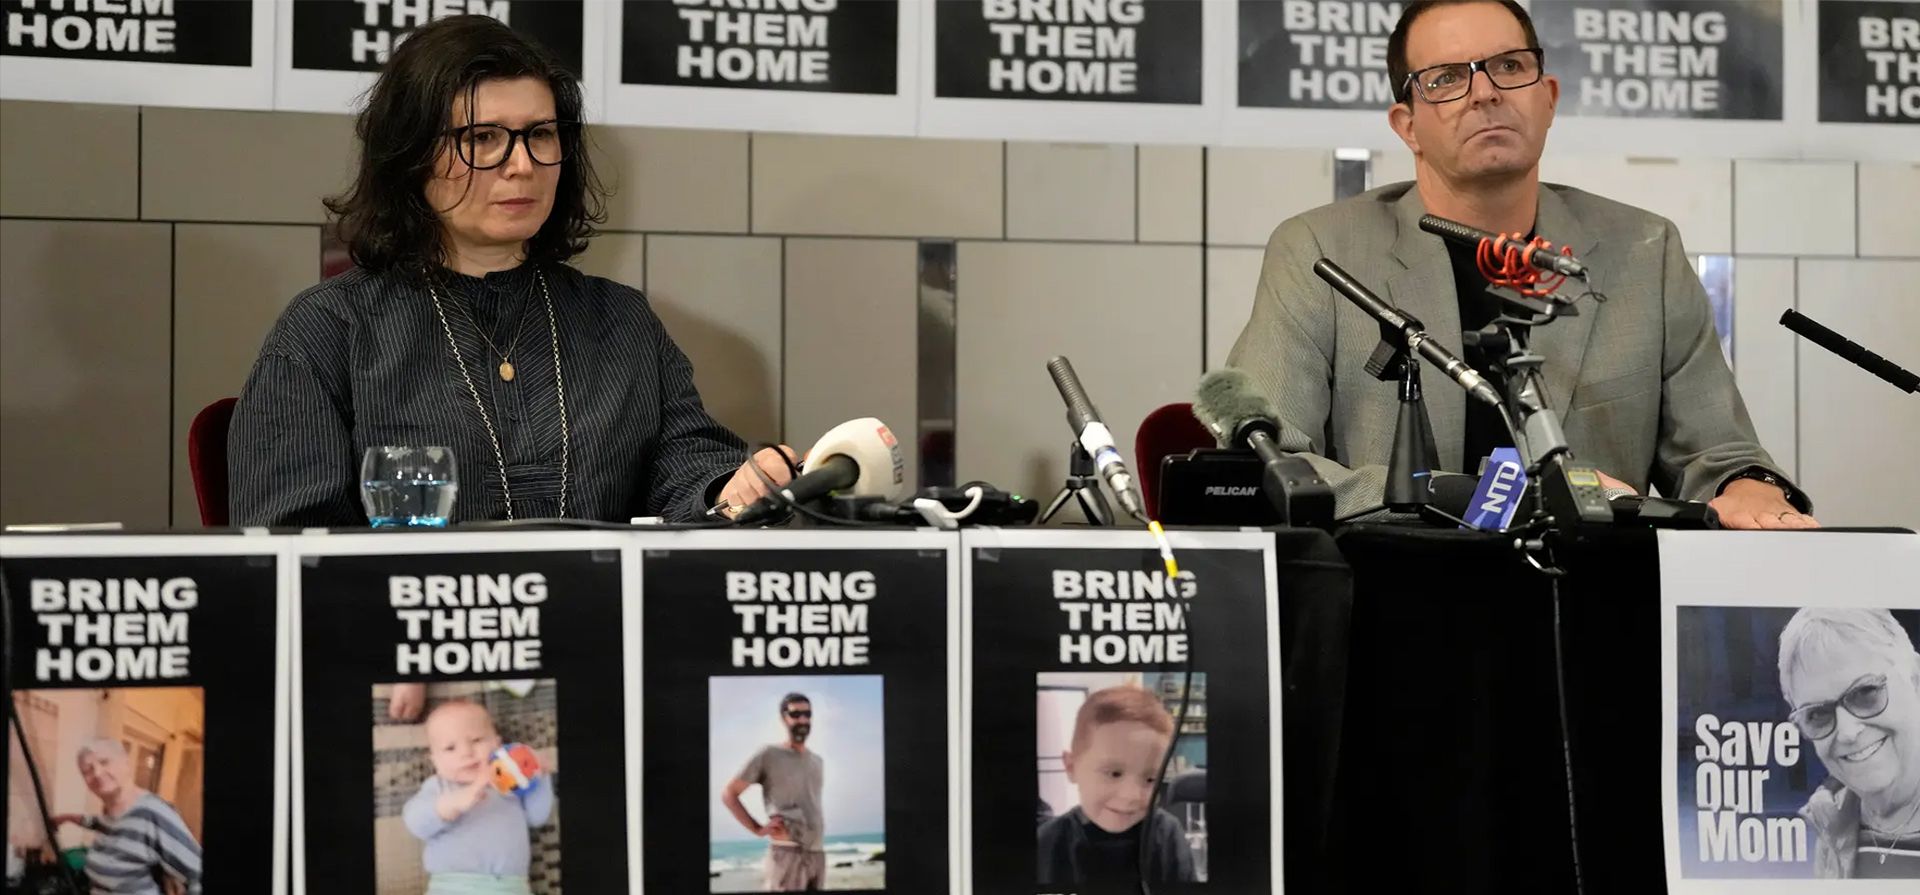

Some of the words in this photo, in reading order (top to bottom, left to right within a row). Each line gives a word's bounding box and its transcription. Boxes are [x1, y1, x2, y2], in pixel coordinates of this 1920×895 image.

[8, 13, 176, 52] HOME
[678, 9, 829, 47] THEM
[1283, 0, 1402, 34] BRIN
[1574, 8, 1727, 43] BRING
[989, 23, 1136, 58] THEM
[1290, 34, 1389, 68] THE
[677, 45, 830, 82] HOME
[989, 58, 1137, 93] HOME
[1580, 43, 1718, 77] THEM
[1289, 69, 1396, 103] HOM
[1580, 77, 1719, 110] HOME
[1205, 486, 1256, 496] PELICAN
[1480, 461, 1521, 514] NTD
[31, 577, 198, 612] BRING
[389, 573, 548, 607] BRING
[726, 571, 876, 602] BRING
[1052, 570, 1197, 600] BRING
[38, 612, 189, 645] THEM
[397, 607, 540, 640] THEM
[733, 604, 868, 634] THEM
[1059, 602, 1190, 631] THEM
[36, 647, 190, 681] HOME
[396, 640, 542, 674] HOME
[732, 635, 870, 667] HOME
[1059, 634, 1189, 664] HOME
[1695, 714, 1800, 767] Save
[1696, 762, 1770, 814] Our
[1698, 810, 1807, 863] Mom
